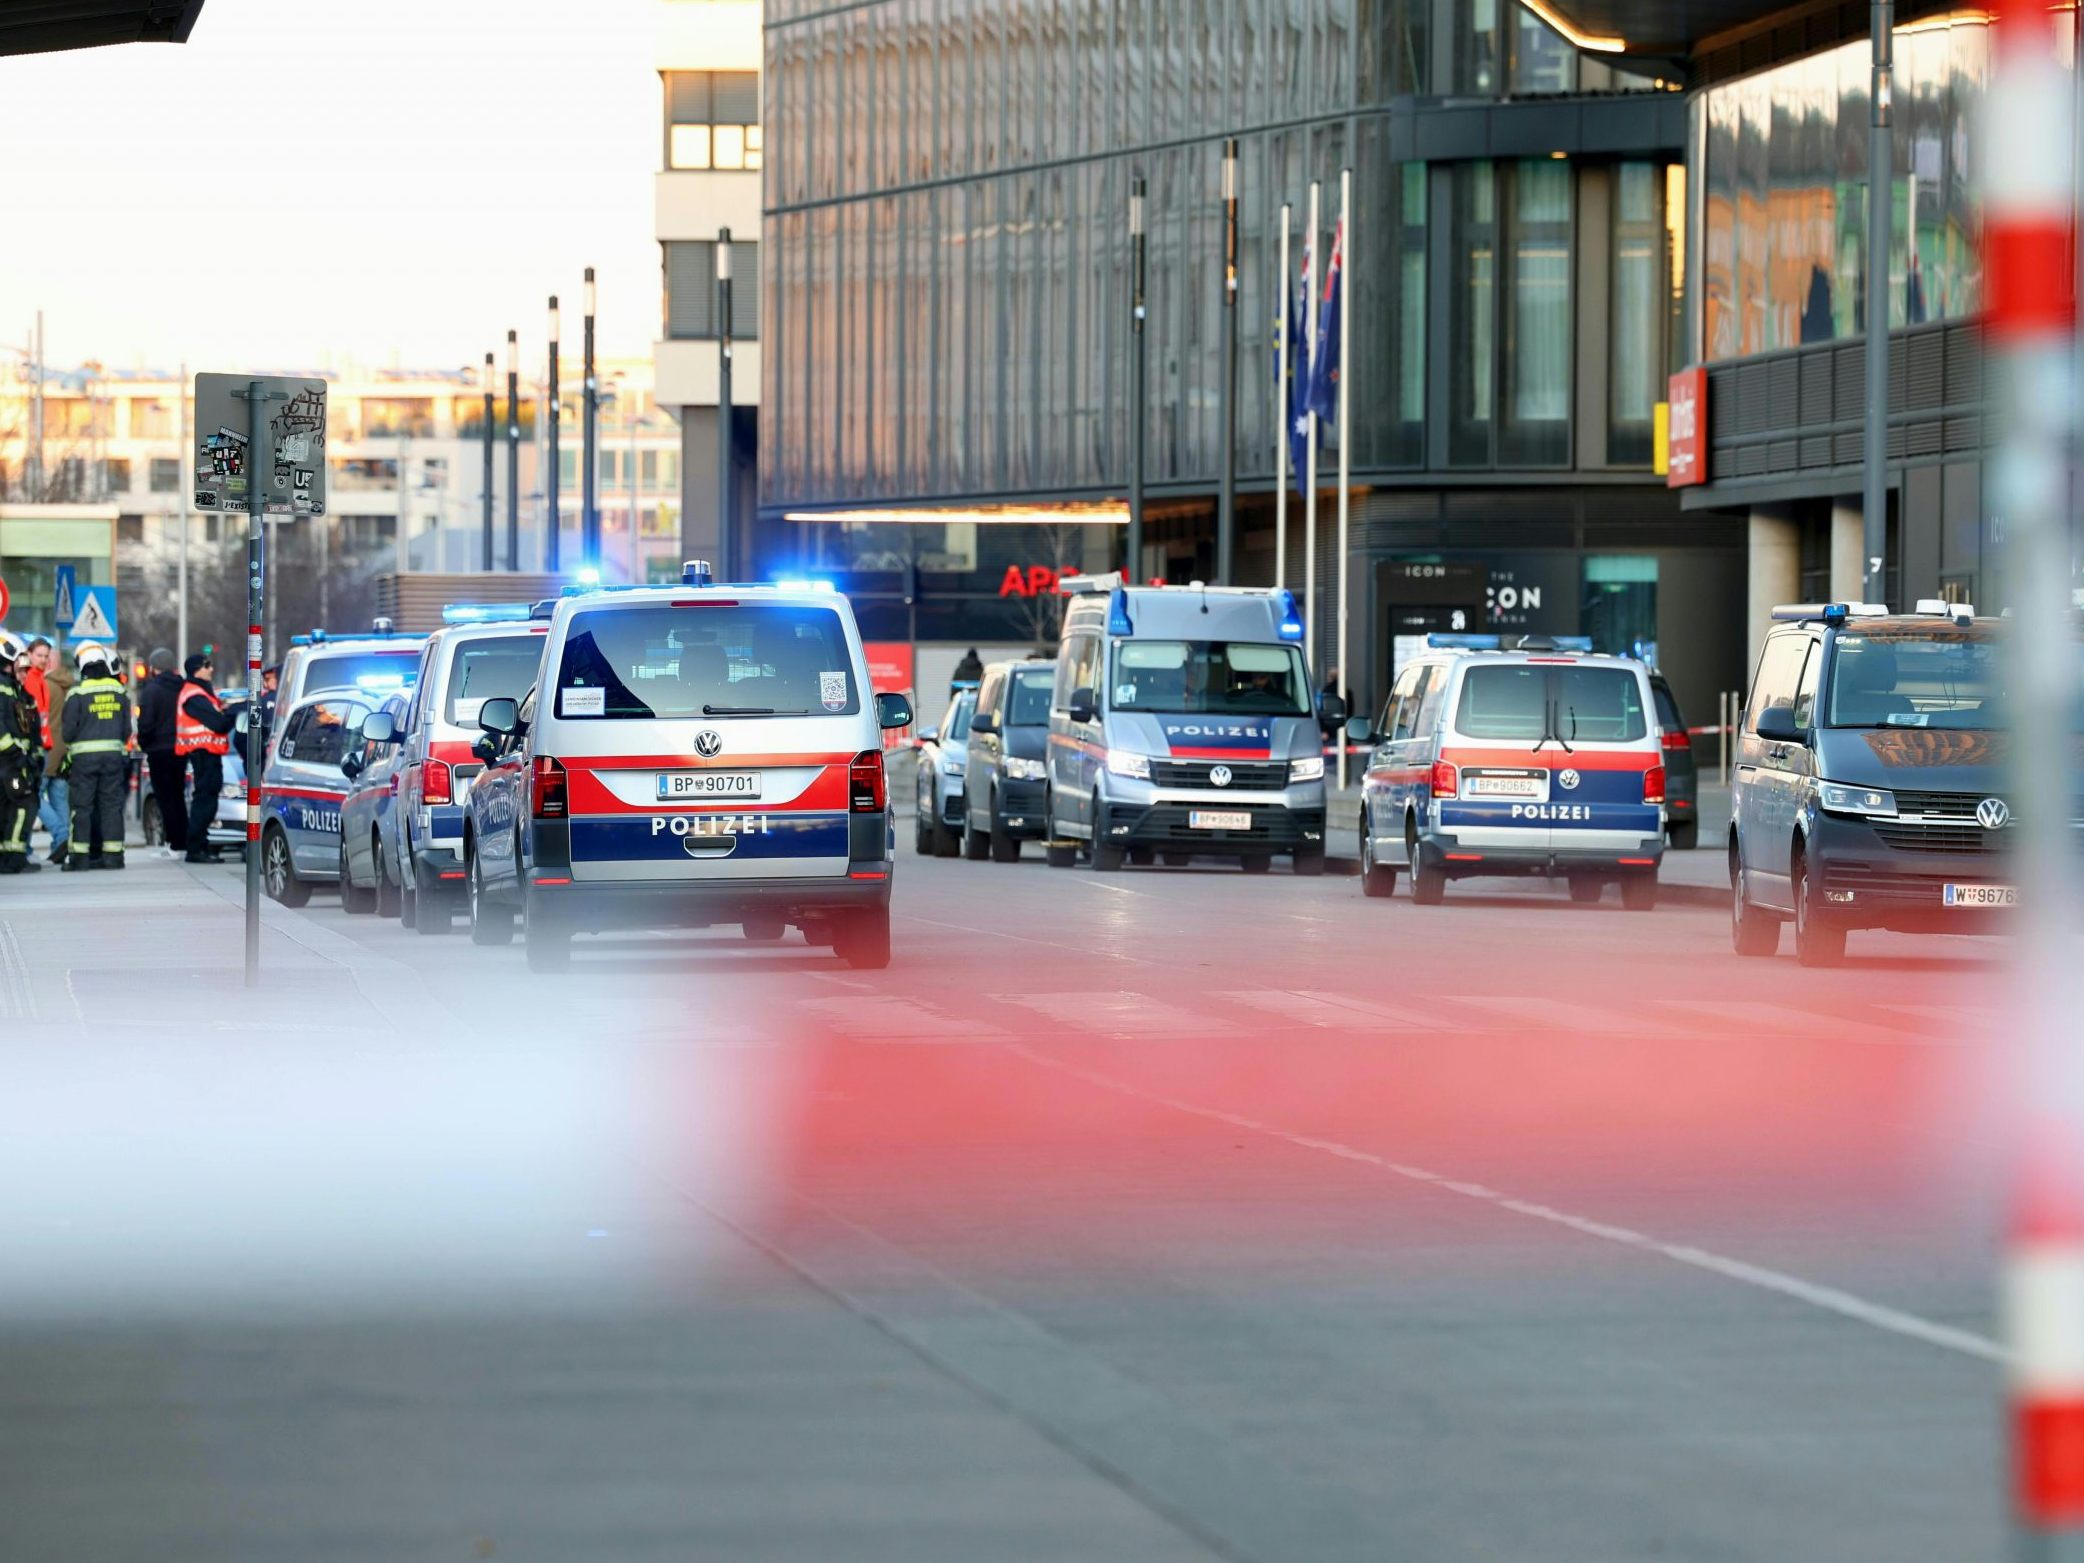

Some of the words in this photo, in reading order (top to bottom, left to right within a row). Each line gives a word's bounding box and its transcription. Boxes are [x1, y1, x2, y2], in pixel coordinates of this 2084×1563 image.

[1405, 565, 1446, 577] ICON
[1167, 725, 1269, 738] POLIZEI
[706, 776, 753, 791] 90701
[1511, 804, 1590, 820] POLIZEI
[302, 809, 342, 833] POLIZEI
[651, 815, 768, 836] POLIZEI
[1977, 887, 2021, 904] 9676
